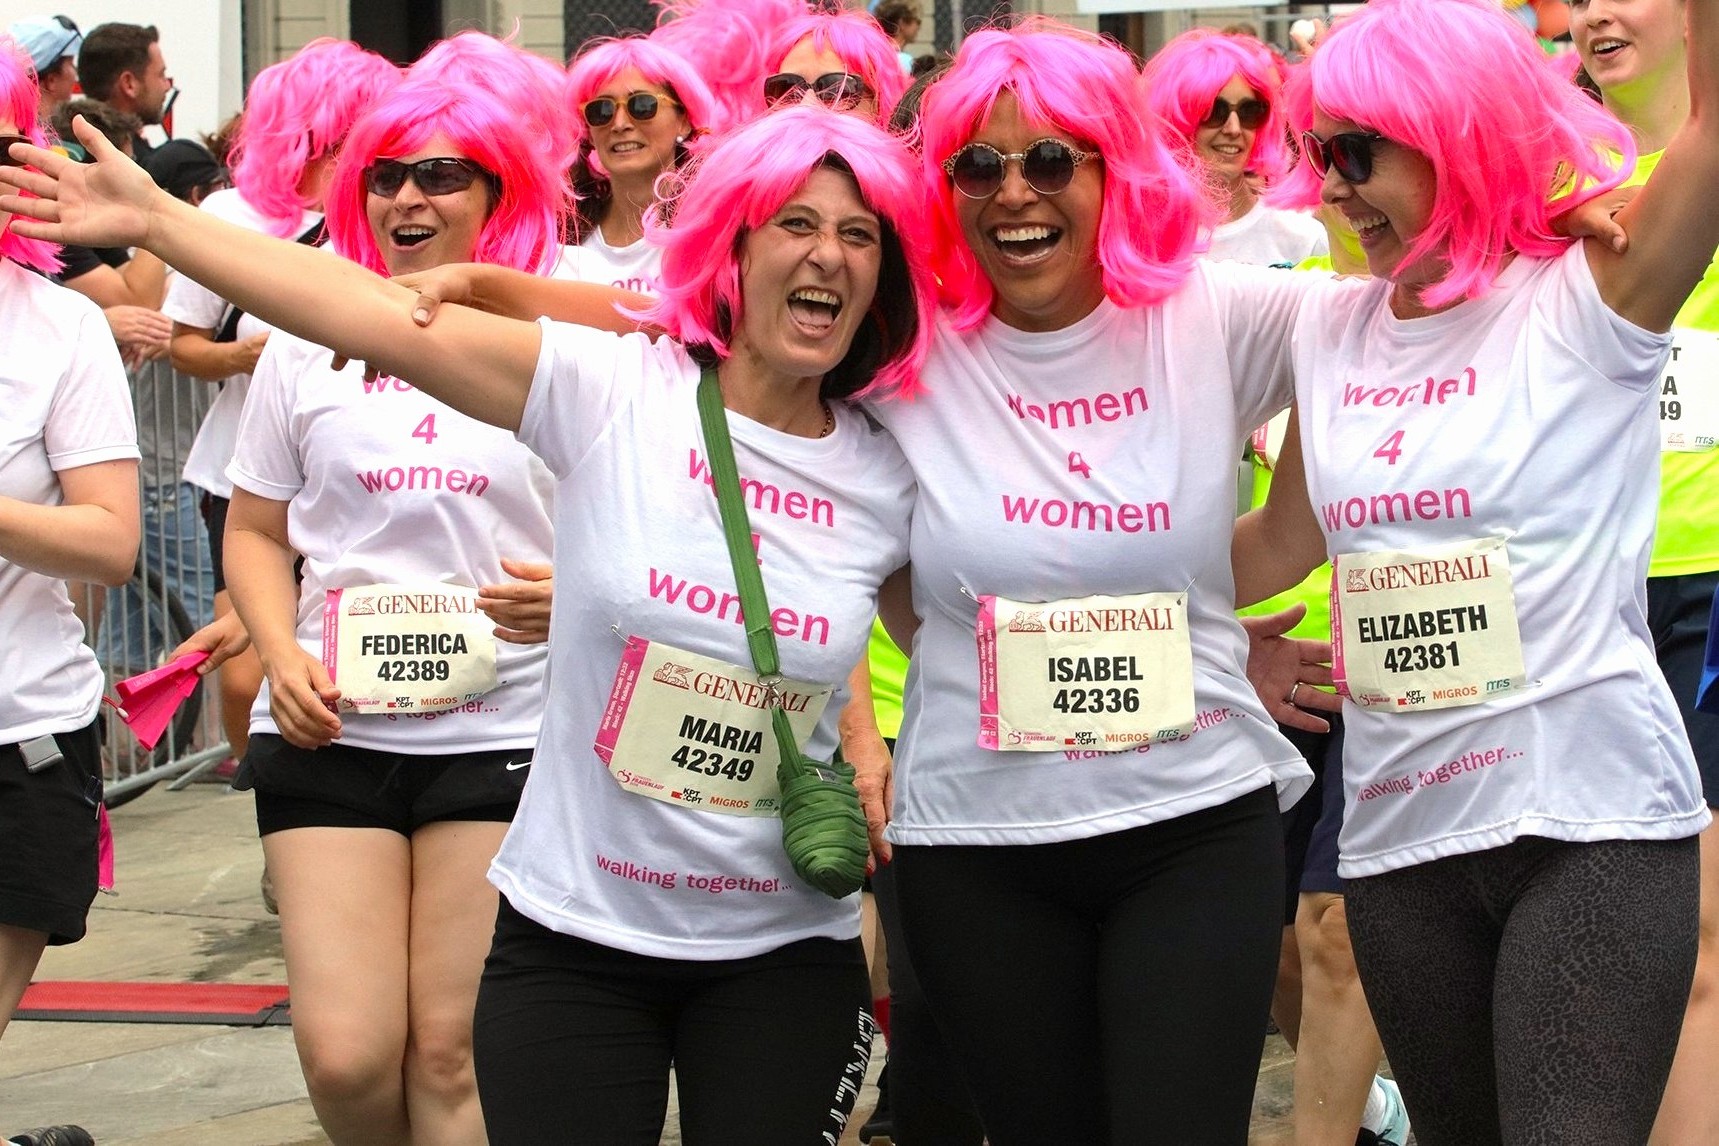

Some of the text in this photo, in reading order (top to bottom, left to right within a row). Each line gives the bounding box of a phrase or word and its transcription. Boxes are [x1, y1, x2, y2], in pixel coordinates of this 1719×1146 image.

[412, 414, 438, 444] 4
[1373, 430, 1405, 465] 4
[356, 466, 489, 497] women
[689, 448, 833, 527] wmen
[1002, 495, 1170, 533] women
[1322, 488, 1471, 533] women
[1370, 554, 1492, 591] GENERALI
[377, 594, 480, 614] GENERALI
[1050, 607, 1173, 633] GENERALI
[1358, 604, 1488, 643] ELIZABETH
[362, 633, 468, 656] FEDERICA
[1384, 641, 1460, 673] 42381
[377, 660, 450, 682] 42389
[1049, 656, 1143, 682] ISABEL
[420, 697, 458, 706] MIGROS
[693, 672, 813, 712] GENERALI
[1053, 688, 1140, 713] 42336
[1433, 686, 1478, 700] MIGROS
[678, 715, 763, 754] MARIA
[1105, 733, 1149, 742] MIGROS
[671, 745, 754, 782] 42349
[683, 788, 700, 798] KPT
[709, 796, 749, 809] MIGROS
[597, 854, 676, 889] walking
